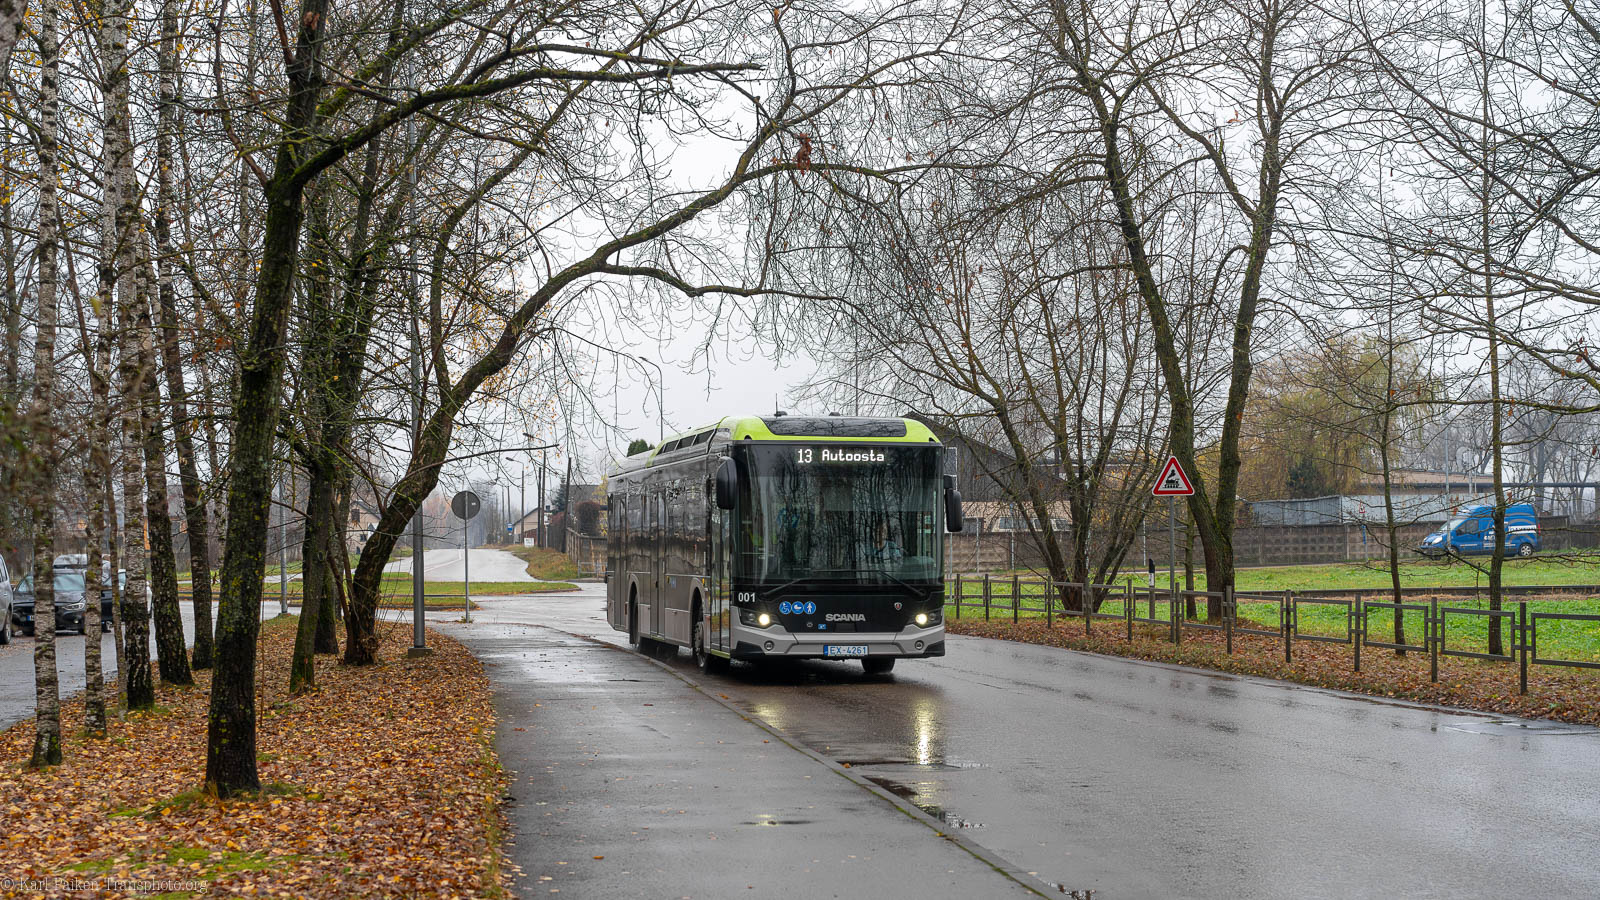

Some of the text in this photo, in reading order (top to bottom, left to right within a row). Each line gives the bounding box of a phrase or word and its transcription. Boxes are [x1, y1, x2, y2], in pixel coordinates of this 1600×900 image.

[797, 448, 885, 463] 13 Autoosta
[738, 592, 756, 603] 001
[825, 613, 866, 622] SCANIA
[830, 646, 866, 654] EX-4261
